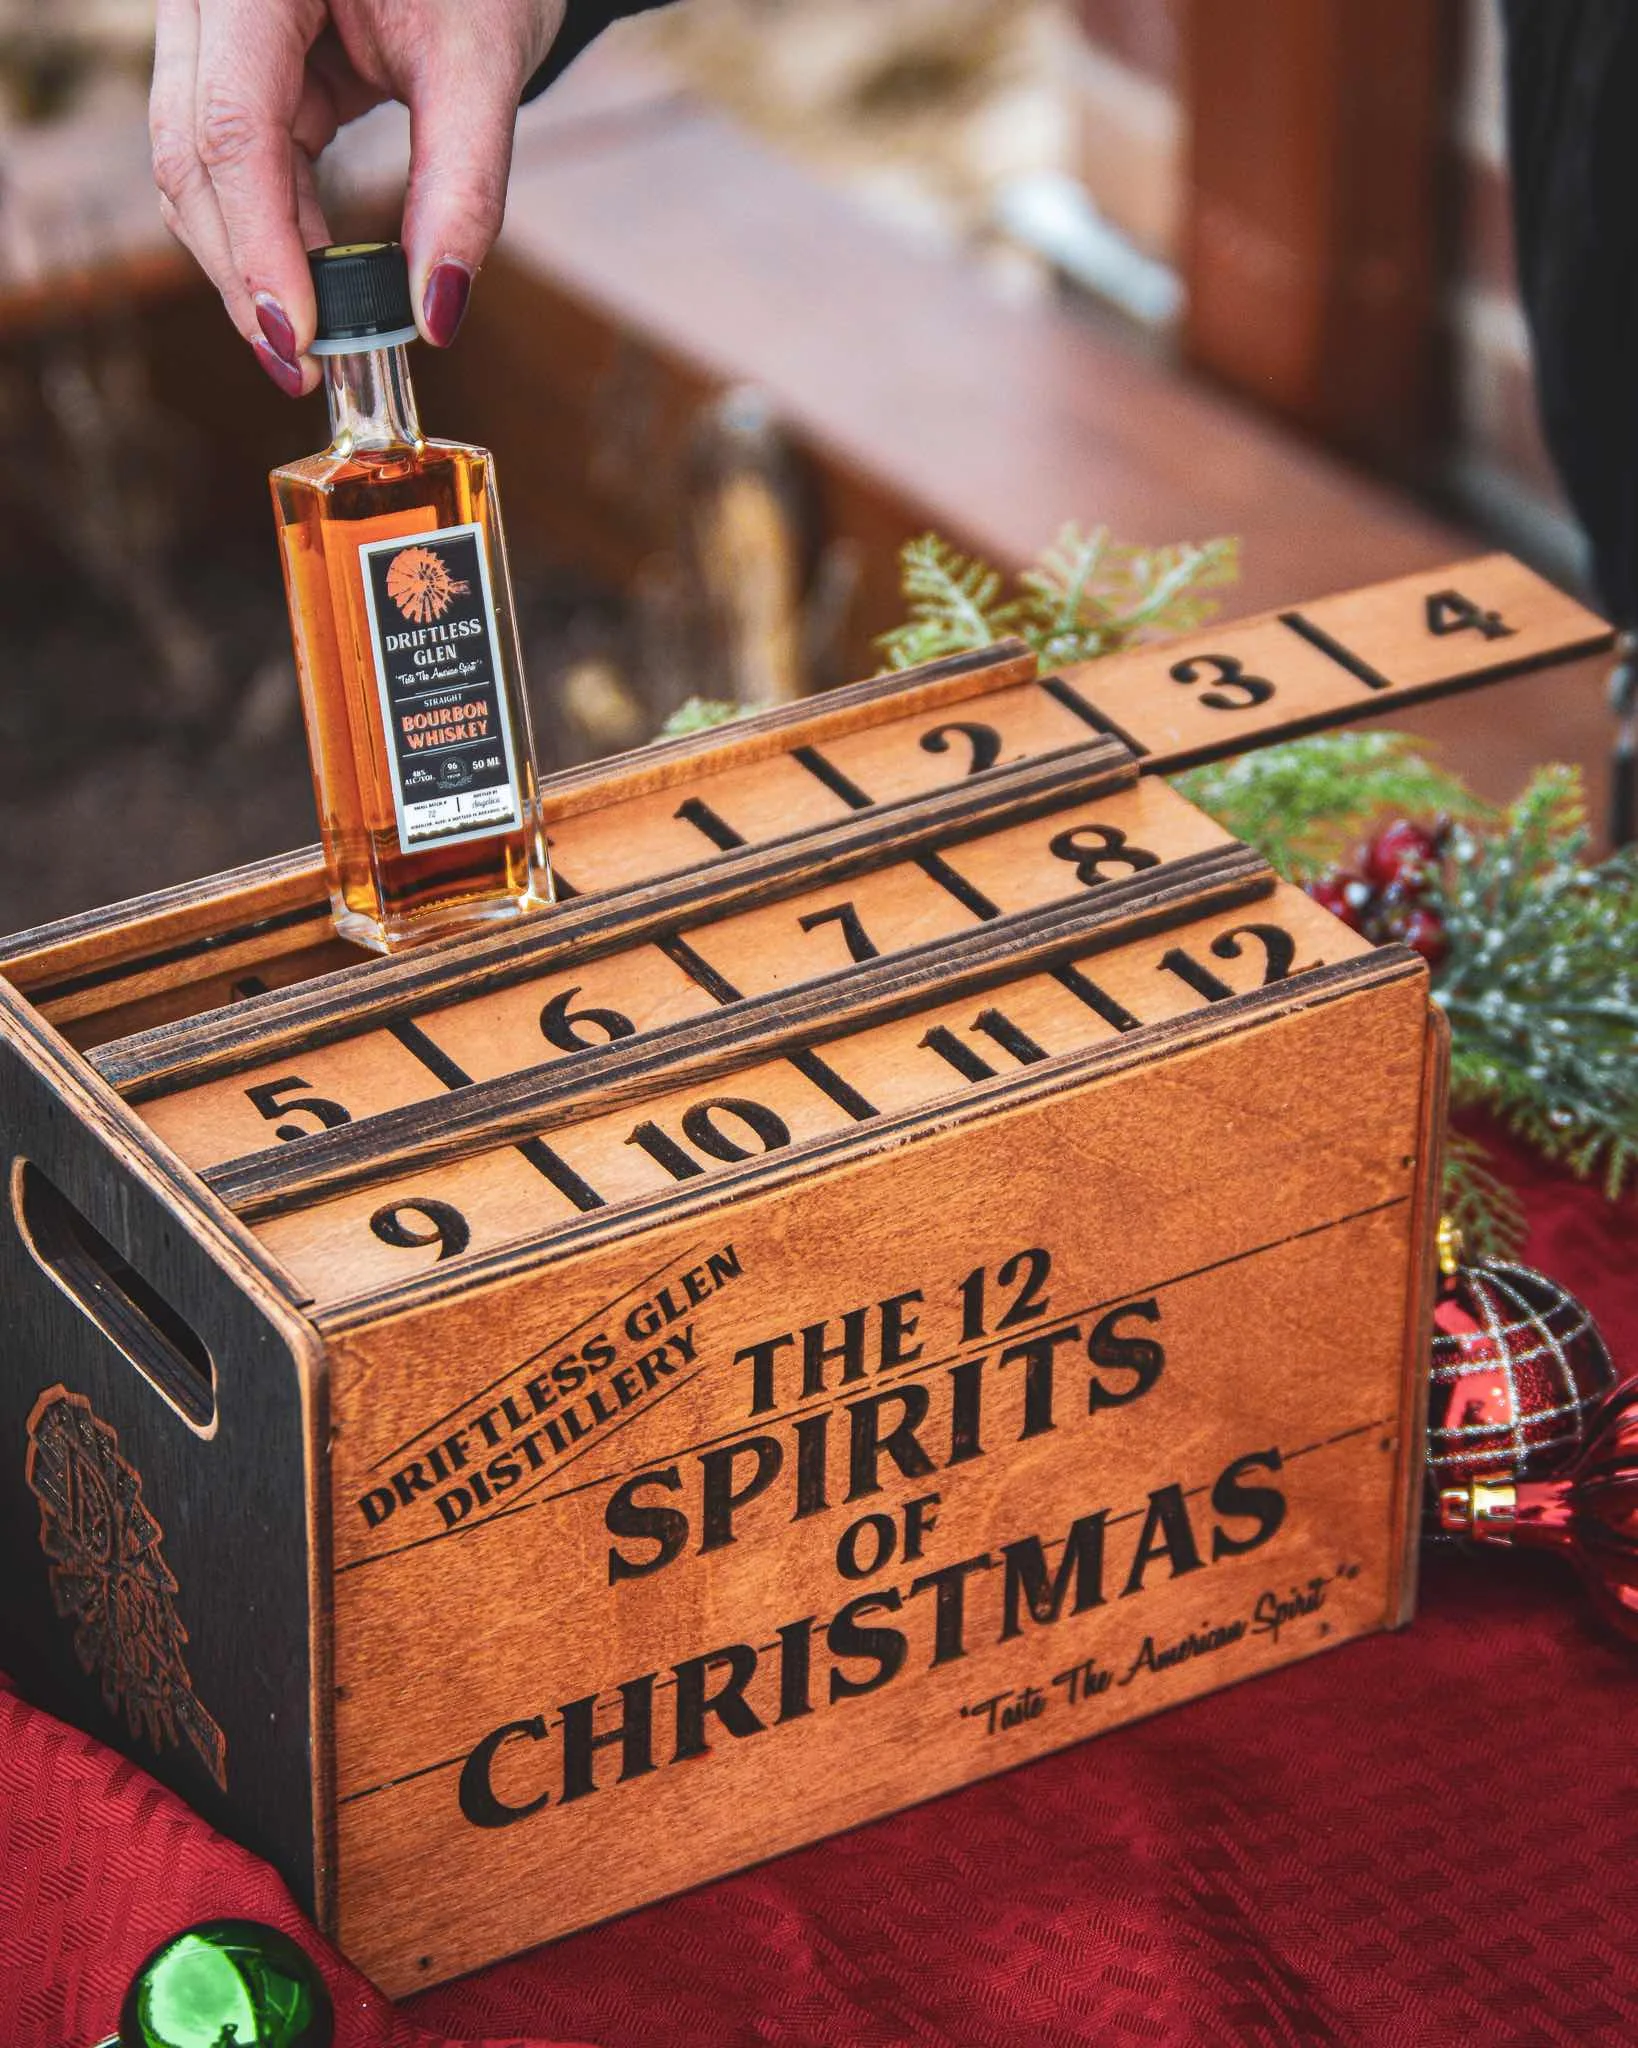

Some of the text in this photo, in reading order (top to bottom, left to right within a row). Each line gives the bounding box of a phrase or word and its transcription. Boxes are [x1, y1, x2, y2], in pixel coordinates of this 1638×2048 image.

[385, 618, 481, 652] DRIFTLESS
[1424, 590, 1517, 641] 4
[413, 643, 457, 666] GLEN
[1169, 655, 1276, 710] 3
[401, 700, 488, 732] BOURBON
[424, 693, 462, 707] STRAIGHT
[406, 720, 488, 750] WHISKEY
[447, 762, 458, 770] 96
[472, 760, 484, 770] 50
[919, 722, 1025, 775] 2
[673, 797, 747, 851] 1
[1050, 824, 1160, 887] 8
[799, 902, 880, 963] 7
[1156, 924, 1324, 1003] 12
[539, 987, 635, 1052] 6
[918, 1008, 1050, 1083] 11
[244, 1076, 351, 1141] 5
[624, 1098, 790, 1182] 10
[369, 1198, 470, 1261] 9
[733, 1247, 1052, 1417] THE 12
[357, 1244, 745, 1529] DRIFTLESS GLEN
[434, 1324, 698, 1529] DISTILLERY
[604, 1297, 1165, 1586] SPIRITS
[836, 1492, 941, 1580] OF
[457, 1447, 1288, 1829] CHRISTMAS
[1052, 1658, 1114, 1706] The
[1117, 1620, 1247, 1687] American
